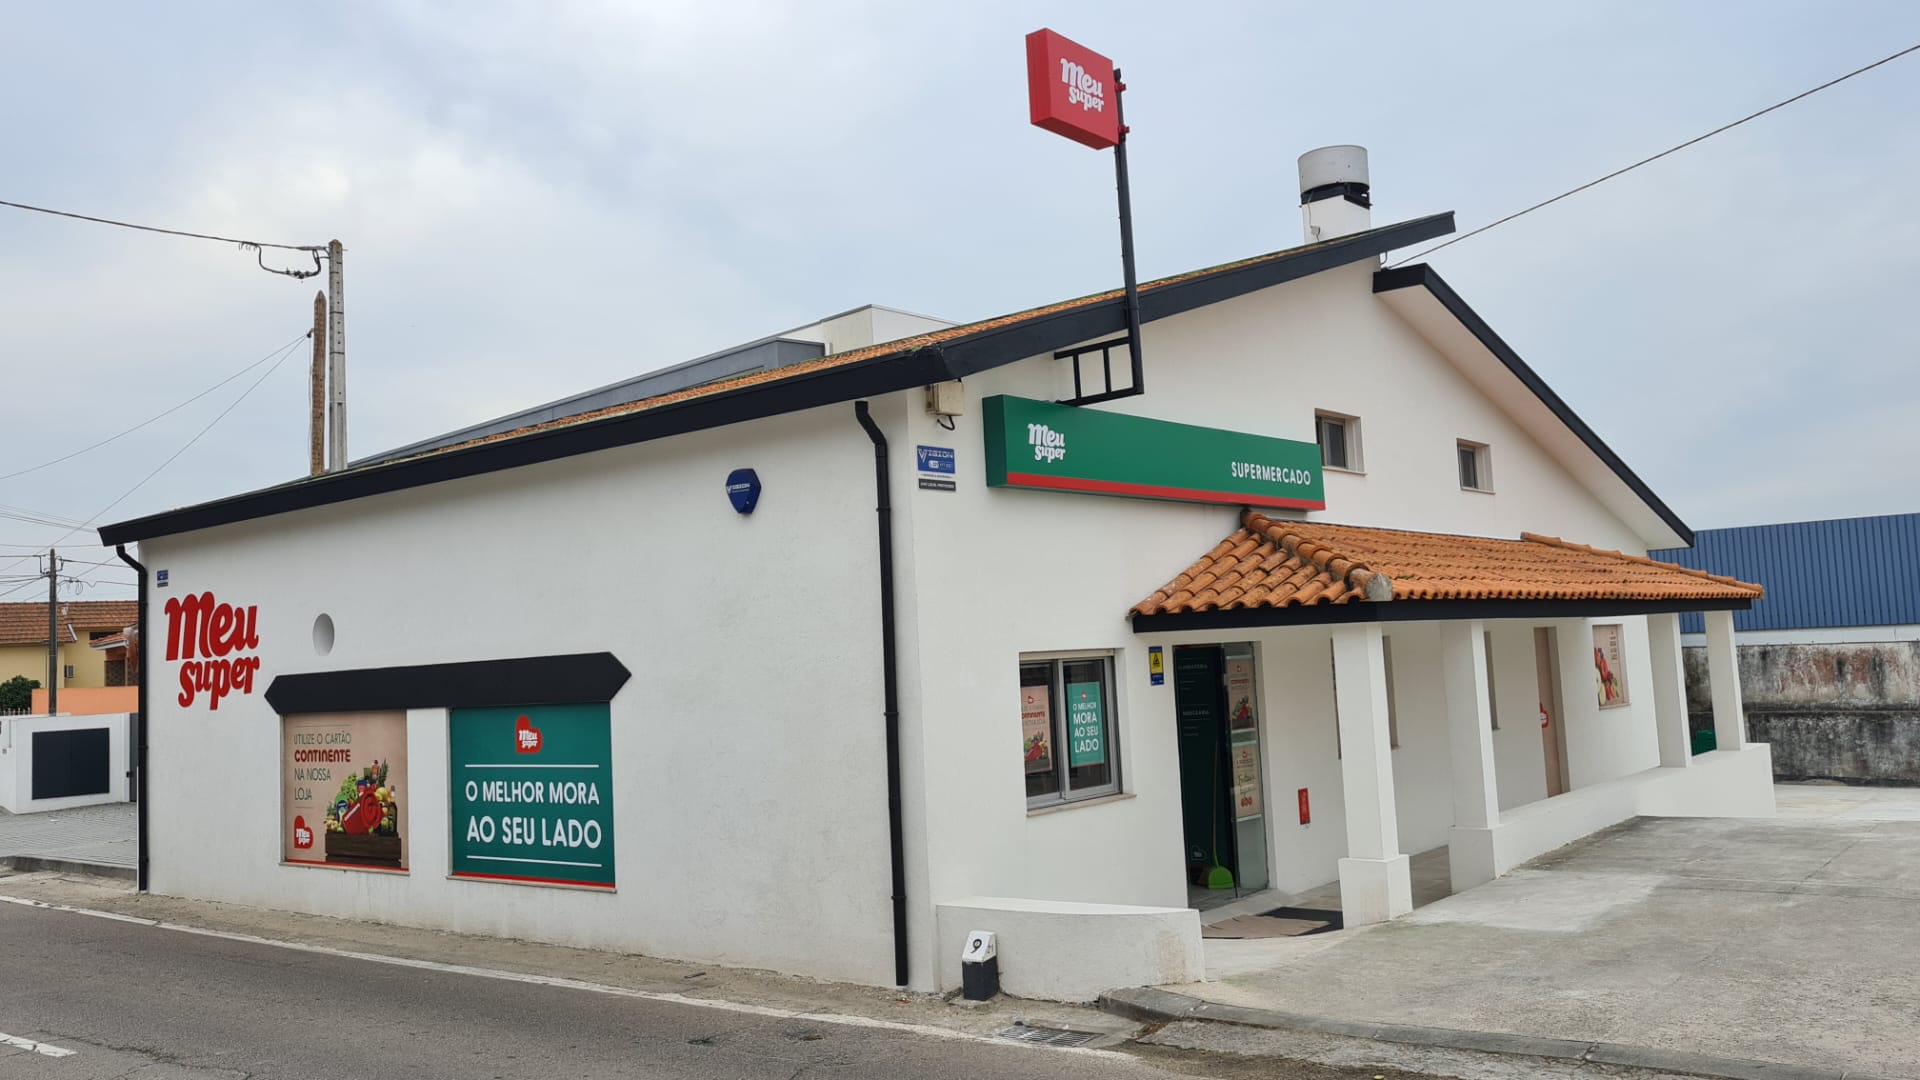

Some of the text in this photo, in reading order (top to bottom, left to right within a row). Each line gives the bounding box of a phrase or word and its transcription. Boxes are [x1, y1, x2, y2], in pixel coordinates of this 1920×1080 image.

[1060, 58, 1103, 97] Meu
[1068, 86, 1104, 112] super
[1027, 423, 1066, 448] Meu
[1034, 445, 1066, 463] super
[1231, 461, 1311, 486] SUPERMERCADO
[164, 591, 259, 661] Meu
[177, 656, 260, 711] super
[1073, 713, 1097, 725] MORA
[294, 730, 352, 745] UTILIZE O CARTÃO
[1074, 726, 1099, 738] AO SEU
[1074, 738, 1099, 753] LADO
[294, 749, 351, 763] CONTINENTE
[294, 768, 331, 781] NA NOSSA
[294, 788, 312, 801] LOJA
[465, 780, 600, 805] O MELHOR MORA
[467, 815, 602, 849] AO SEU LADO
[970, 938, 982, 953] 9
